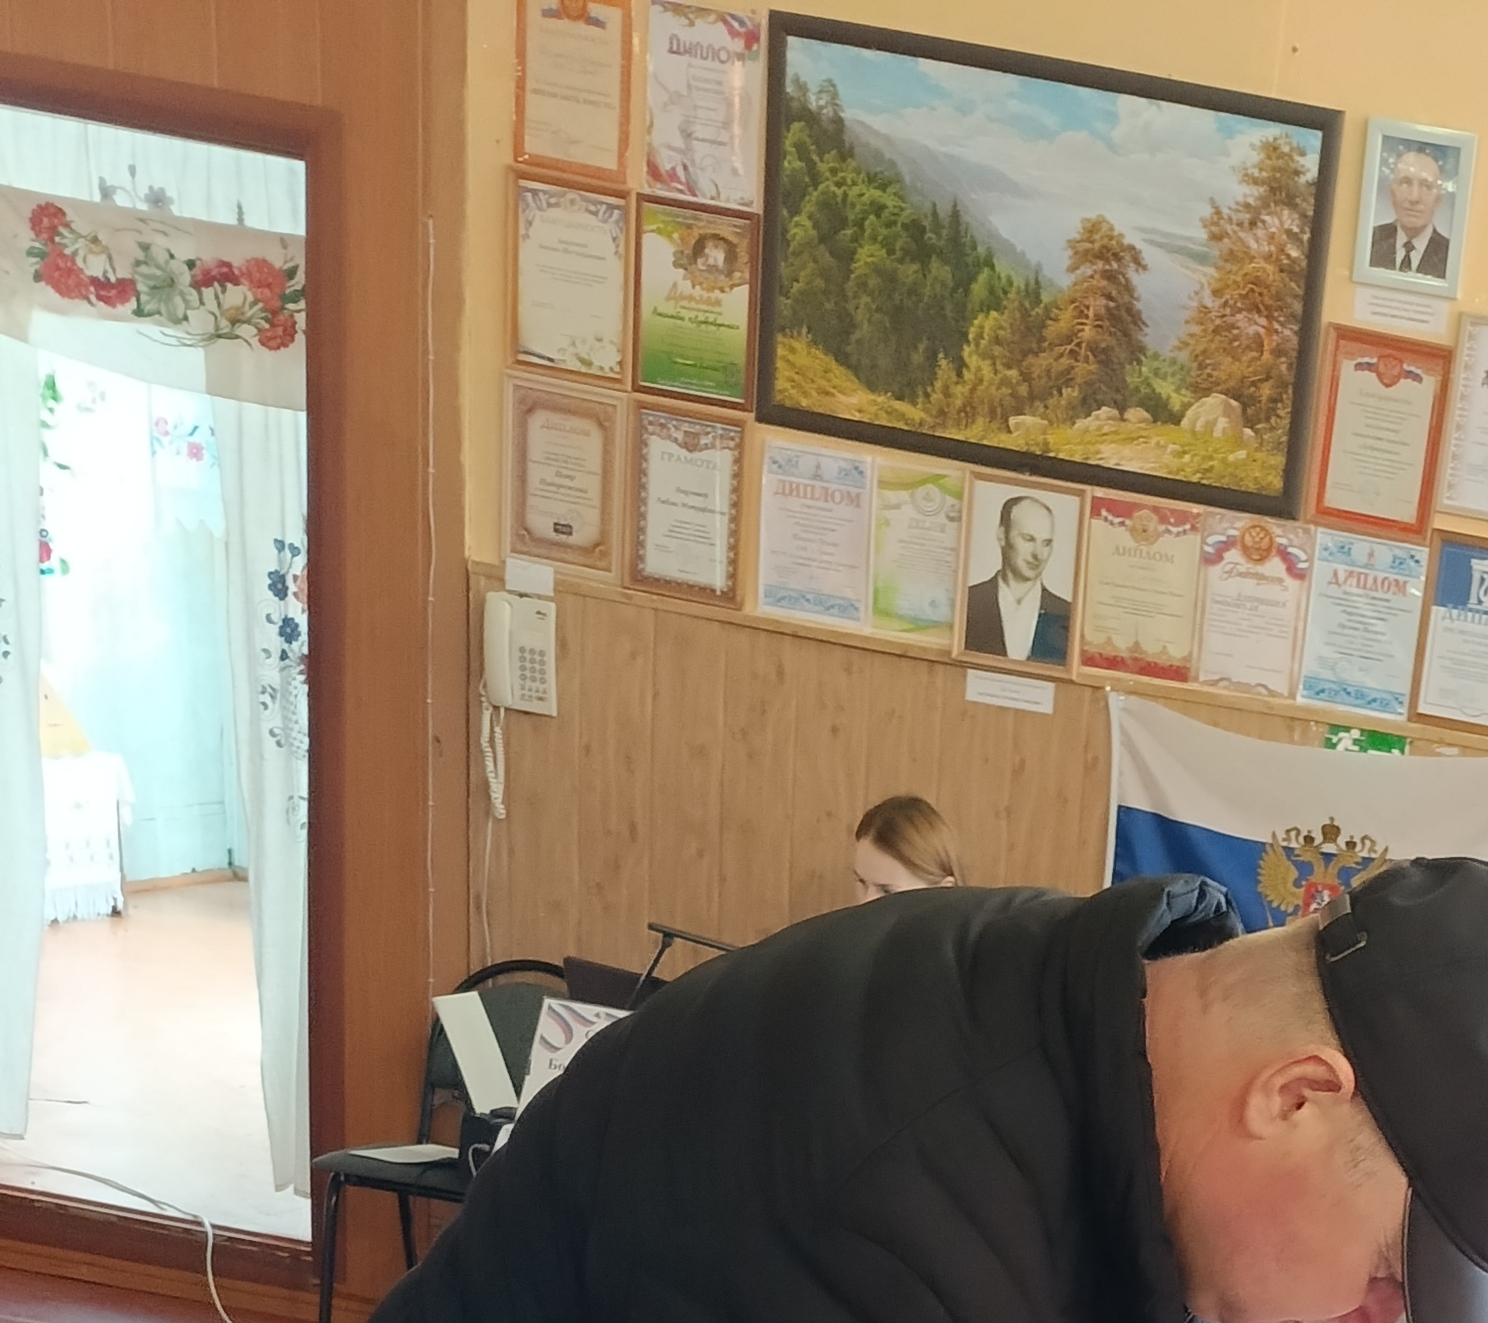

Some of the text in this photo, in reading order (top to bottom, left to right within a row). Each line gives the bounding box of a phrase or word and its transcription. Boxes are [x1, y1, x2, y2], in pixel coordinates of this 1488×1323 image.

[773, 478, 862, 508] ДИПЛОМ
[1111, 544, 1176, 566] ДИПЛОМ
[1328, 568, 1409, 597] ДИПЛОМ
